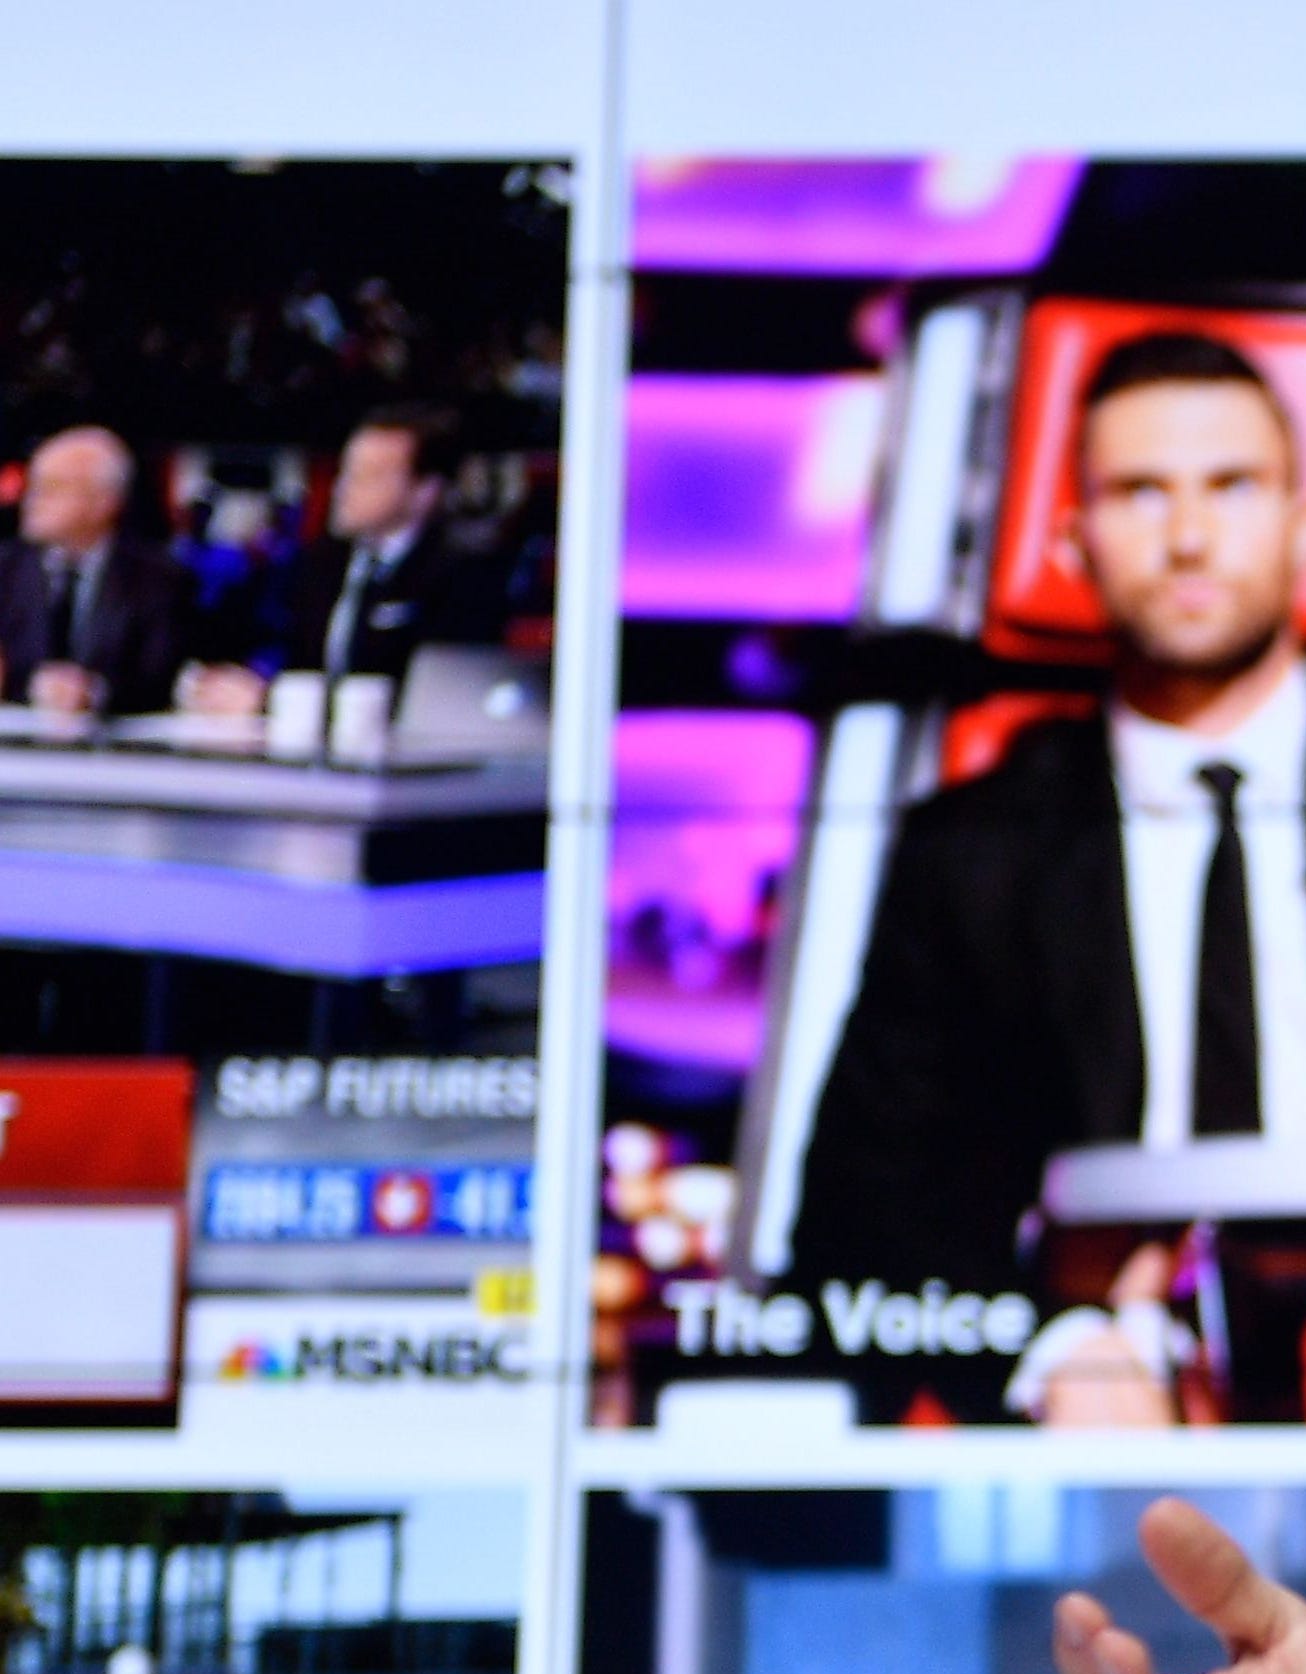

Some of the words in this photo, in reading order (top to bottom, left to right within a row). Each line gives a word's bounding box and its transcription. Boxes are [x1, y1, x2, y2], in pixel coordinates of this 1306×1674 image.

[325, 1057, 537, 1118] FUTURES
[662, 1278, 813, 1356] The
[821, 1278, 1037, 1356] Voice
[297, 1334, 533, 1382] MSNBC
